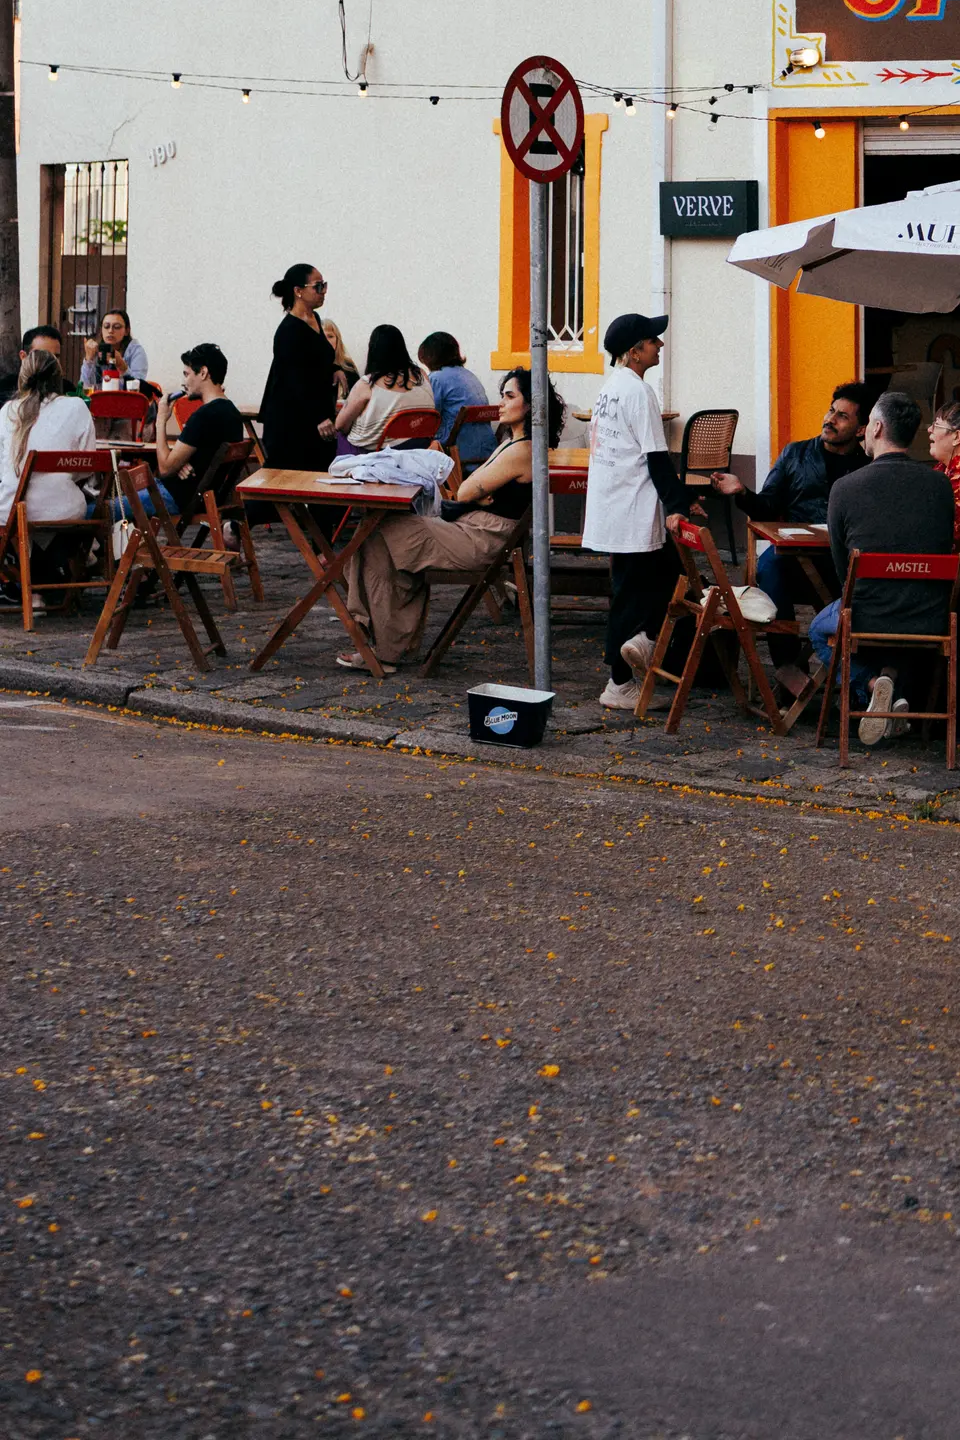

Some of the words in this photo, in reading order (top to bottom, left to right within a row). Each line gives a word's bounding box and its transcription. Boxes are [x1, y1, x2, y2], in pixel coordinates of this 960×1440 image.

[149, 140, 177, 167] 190
[672, 195, 734, 217] VERVE
[56, 457, 93, 468] AMSTEL
[568, 480, 588, 490] AM
[886, 561, 931, 573] AMSTEL
[485, 716, 501, 726] BLUE
[501, 713, 517, 722] MOON
